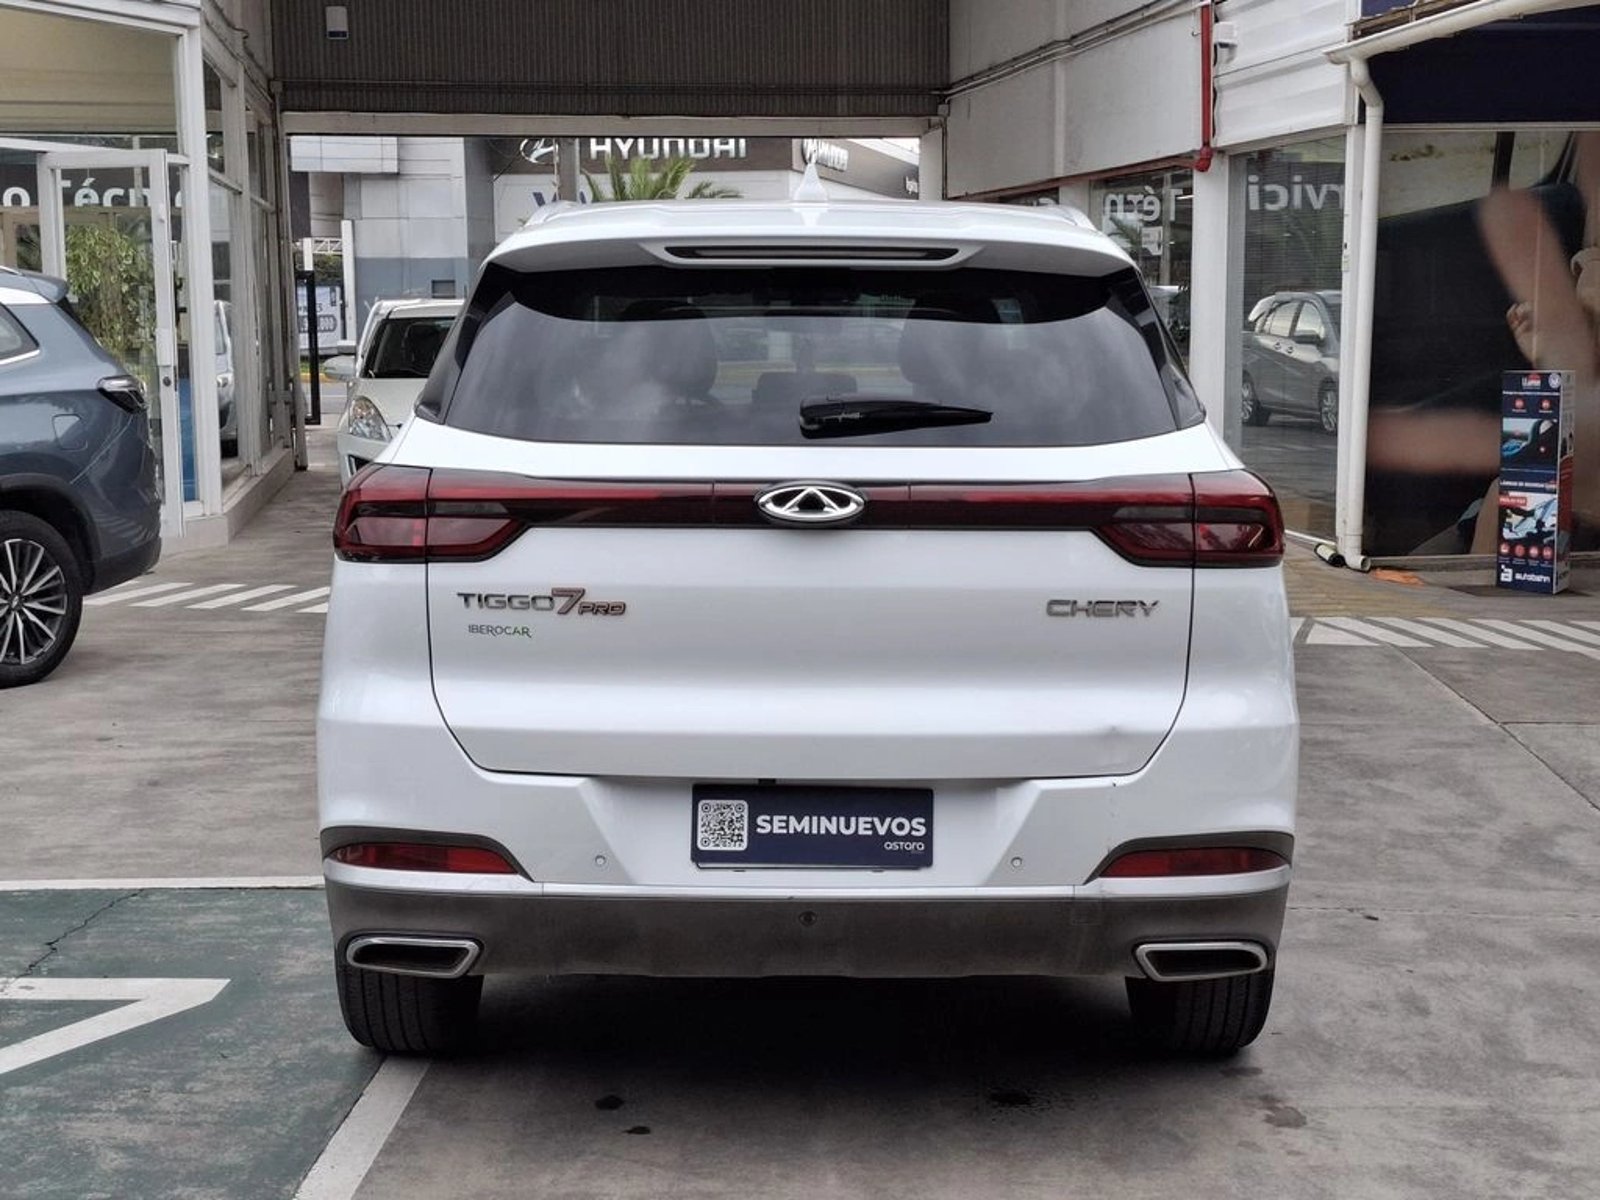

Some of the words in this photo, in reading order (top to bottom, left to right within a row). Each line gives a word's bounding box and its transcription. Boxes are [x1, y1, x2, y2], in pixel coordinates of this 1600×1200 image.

[589, 137, 747, 160] HYUNDAI
[456, 592, 554, 611] TIGGO
[578, 601, 627, 616] PRO
[1046, 599, 1160, 618] CHERY
[468, 624, 532, 638] IBEROCAR
[755, 814, 928, 837] SEMINUEVOS
